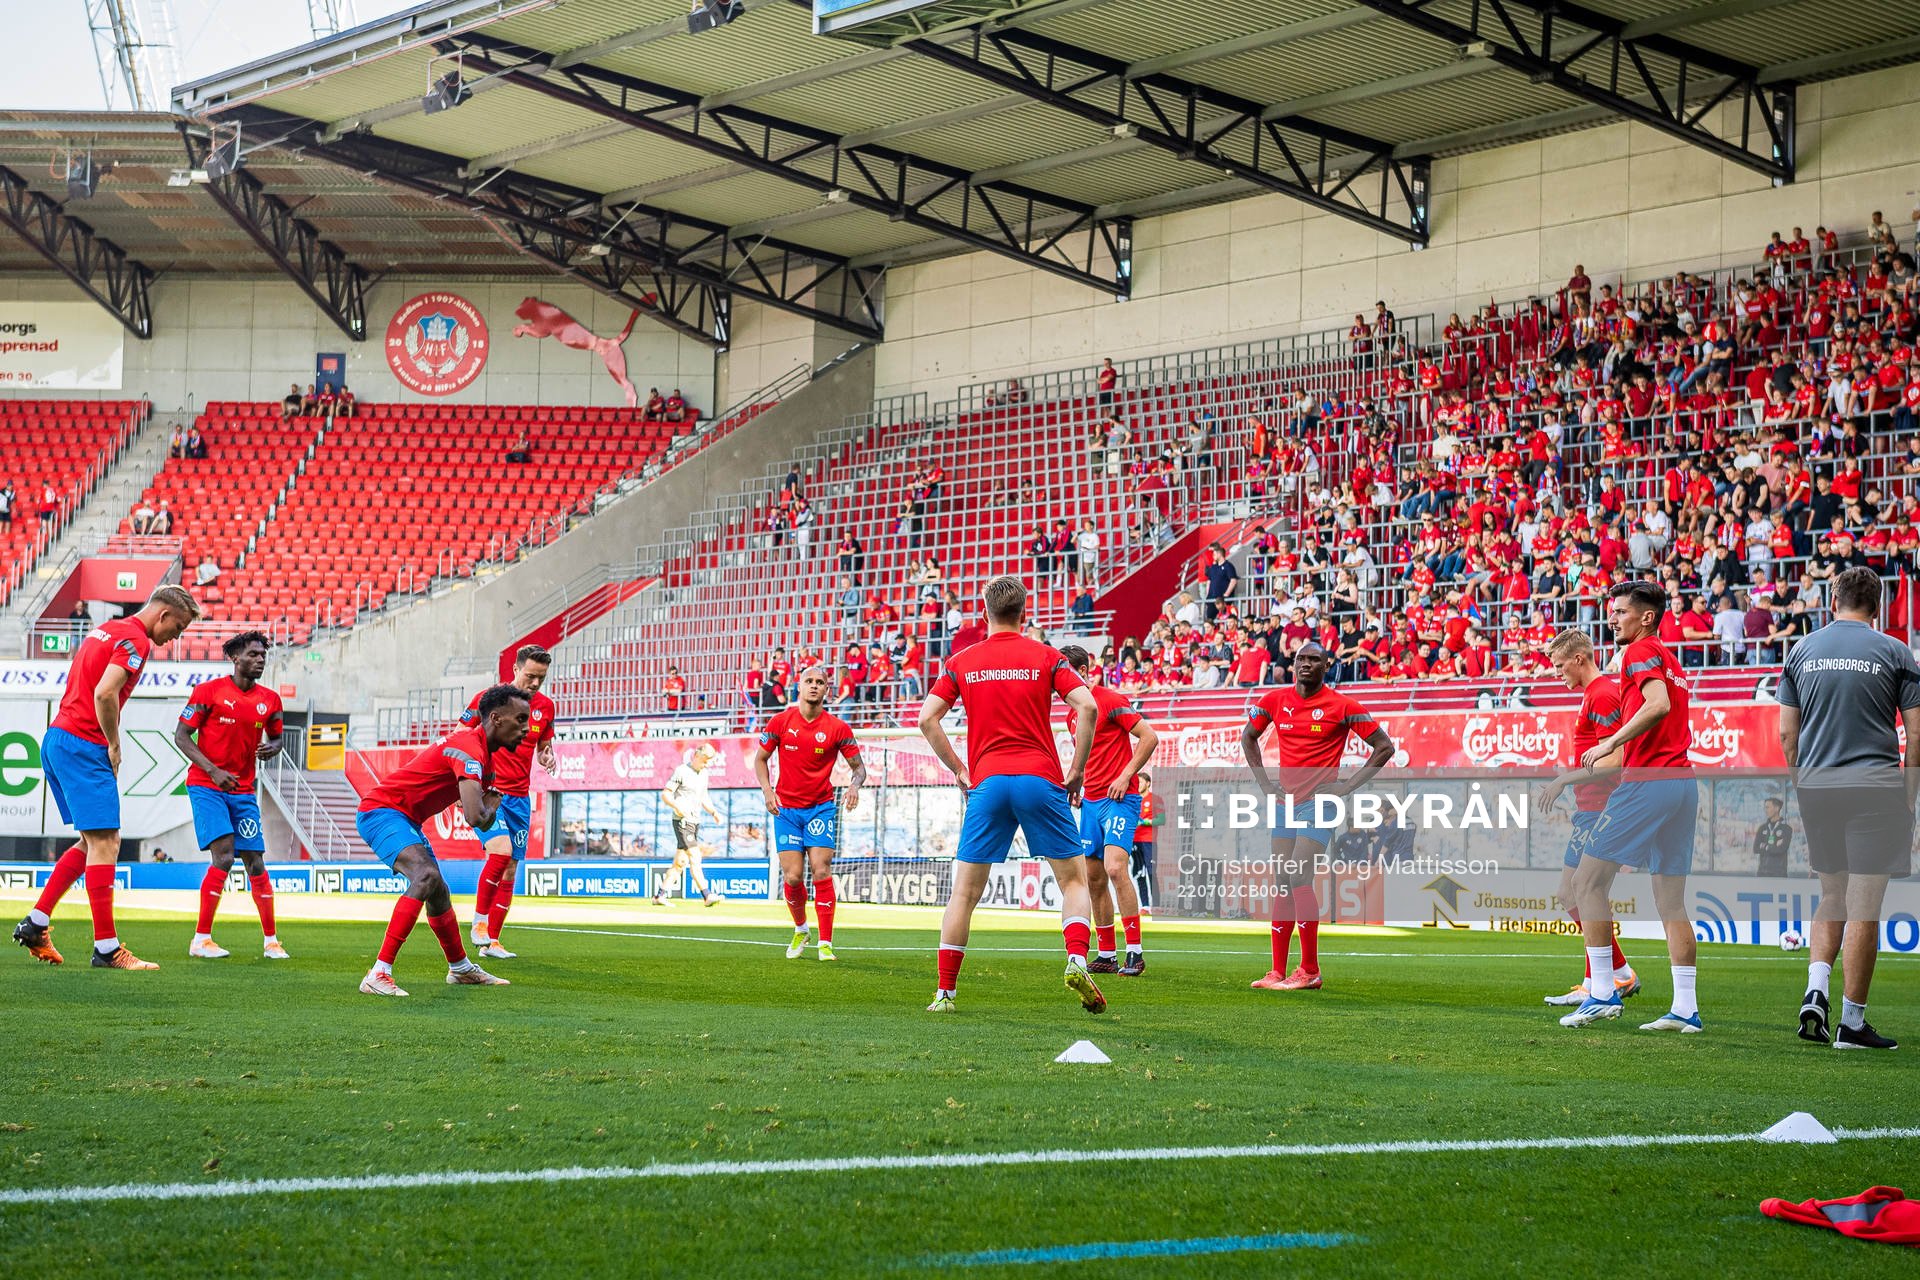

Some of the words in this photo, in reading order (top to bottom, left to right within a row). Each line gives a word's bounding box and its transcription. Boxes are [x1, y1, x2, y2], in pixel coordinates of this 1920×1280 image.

[0, 323, 37, 337] orgs
[1803, 658, 1870, 673] HELSINGBORGS
[1872, 662, 1882, 675] IF
[964, 668, 1029, 684] HELSINGBORGS
[1031, 669, 1040, 681] IF
[1179, 726, 1245, 767] Carlsbe
[1462, 716, 1562, 764] Carlsberg
[629, 752, 655, 769] beat
[0, 805, 36, 817] ROUP
[1112, 816, 1126, 831] 13
[1571, 826, 1590, 846] 24
[316, 872, 341, 893] NP
[347, 878, 362, 892] NP
[363, 878, 408, 893] NILSSON
[530, 873, 557, 897] NP
[567, 878, 584, 893] NP
[585, 878, 640, 895] NILSSON
[710, 878, 768, 896] NILSSON
[1474, 892, 1546, 911] Jönssons
[1500, 916, 1583, 936] Helsingbo
